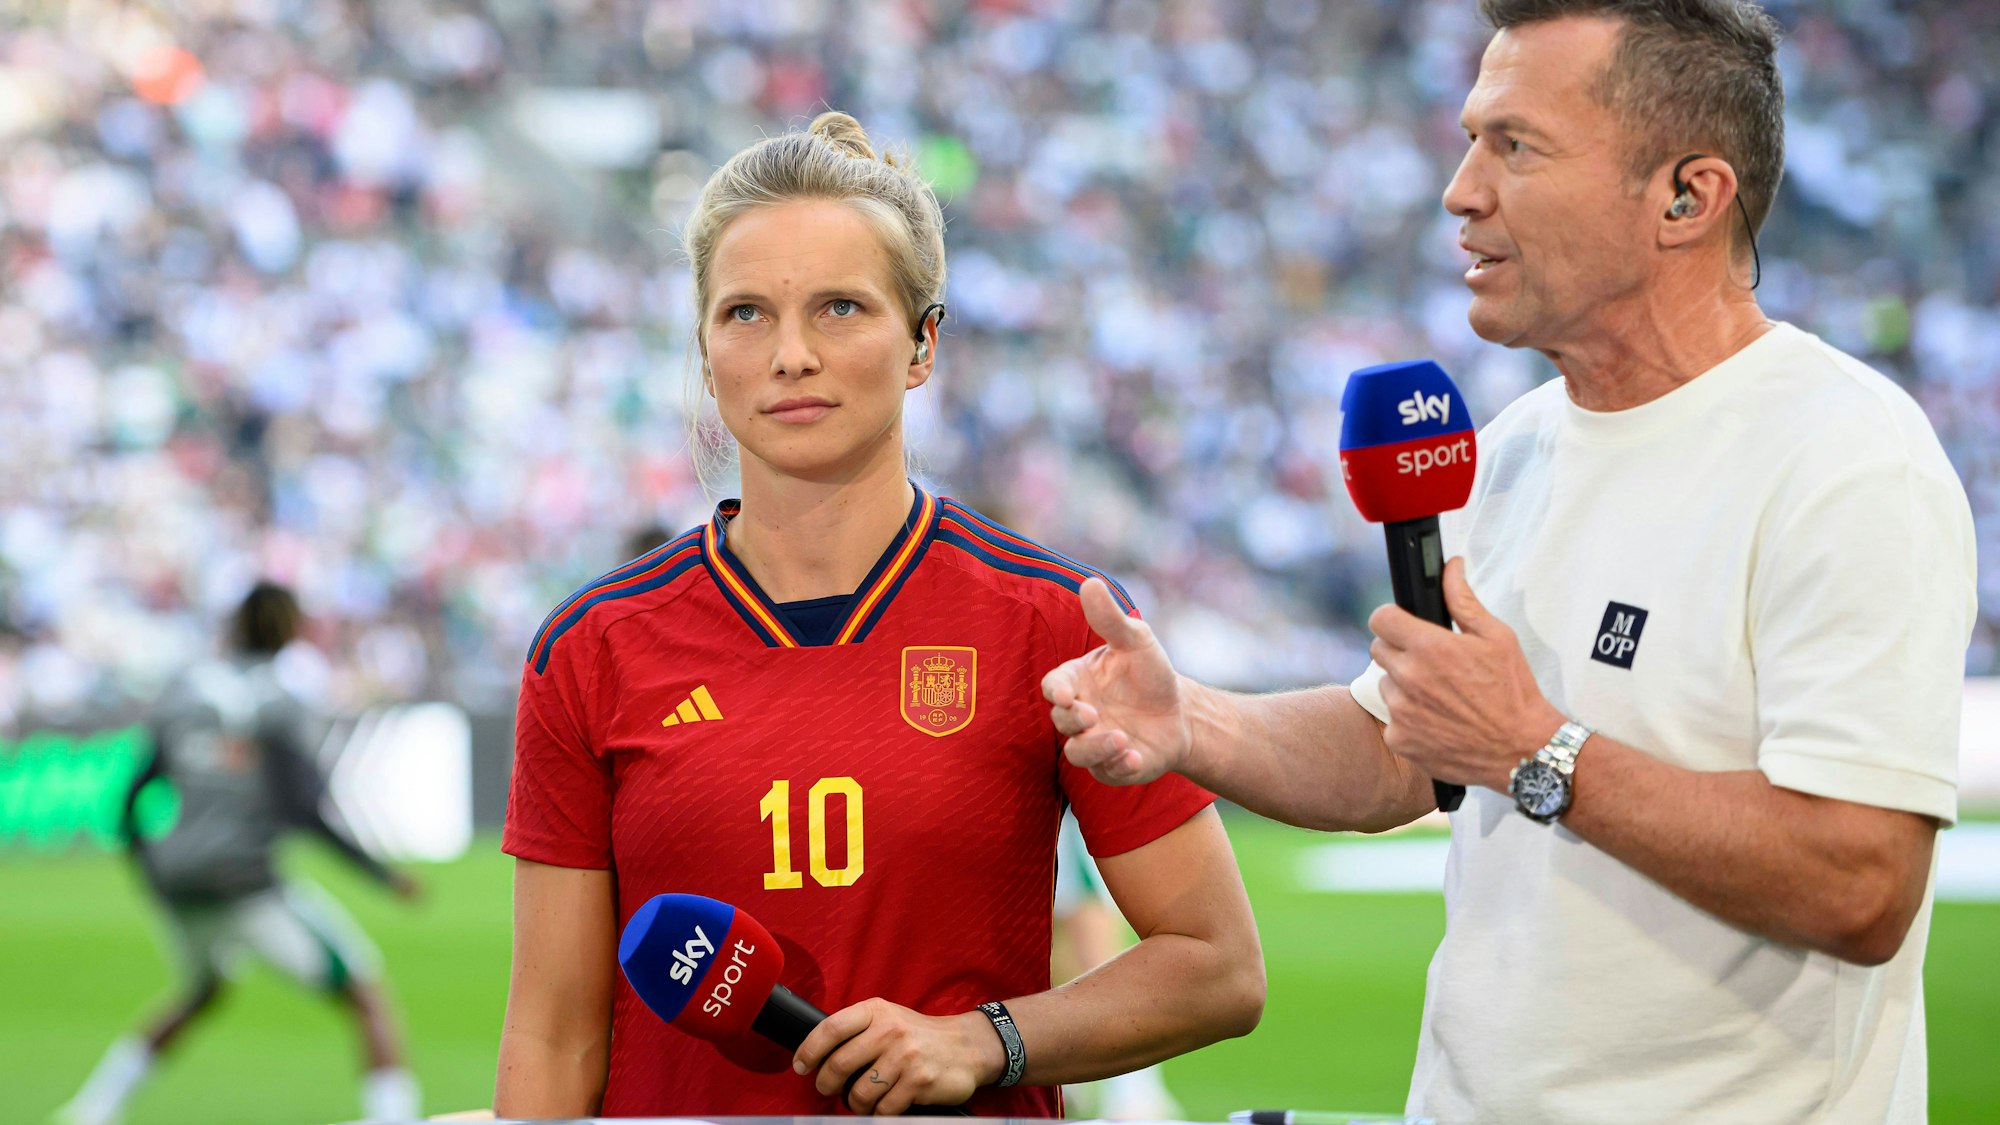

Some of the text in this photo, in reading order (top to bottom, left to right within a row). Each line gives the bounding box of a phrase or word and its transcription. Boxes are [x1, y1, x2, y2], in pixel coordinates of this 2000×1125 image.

[1397, 390, 1450, 425] sky
[1396, 438, 1471, 477] sport
[1610, 611, 1636, 636] M
[760, 776, 864, 890] 10
[669, 925, 715, 985] sky
[702, 939, 755, 1018] sport
